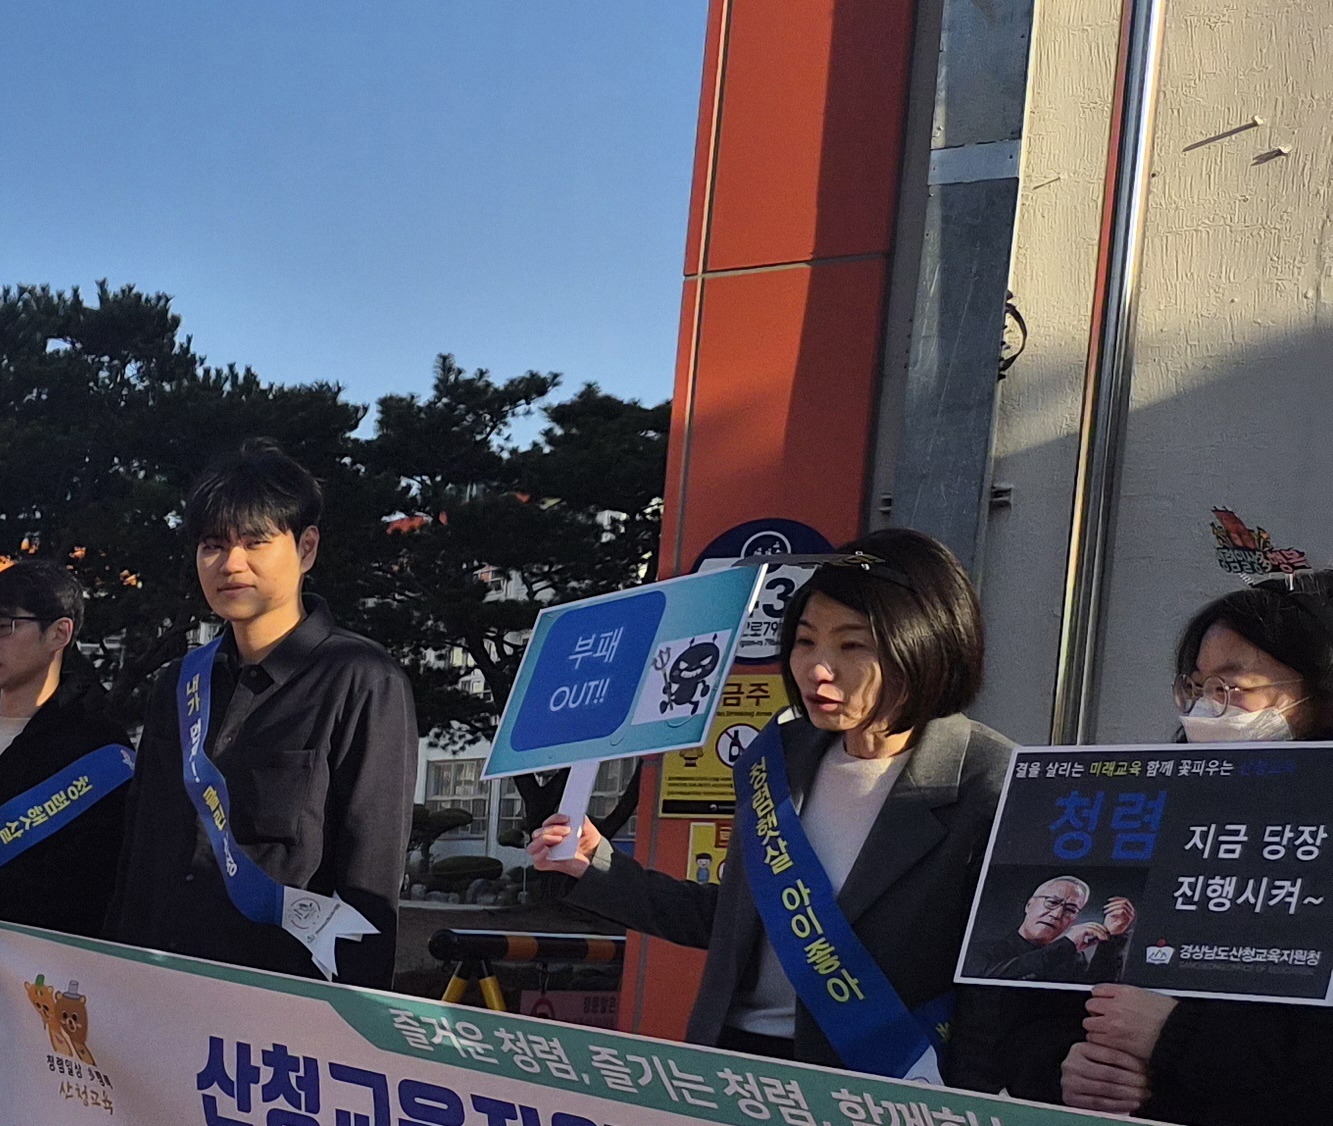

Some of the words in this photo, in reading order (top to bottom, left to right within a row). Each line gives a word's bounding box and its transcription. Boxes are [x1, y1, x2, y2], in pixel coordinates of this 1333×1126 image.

[569, 626, 624, 669] 부패
[186, 672, 201, 717] 내가
[549, 678, 610, 712] OUT!!
[721, 682, 771, 708] 금주
[1015, 761, 1042, 779] 결을
[1045, 760, 1085, 778] 살리는
[1089, 760, 1142, 778] 미래교육
[1145, 760, 1174, 777] 함께
[1177, 759, 1234, 777] 꽃피우는
[749, 756, 795, 876] 청렴햇살
[1048, 790, 1168, 860] 청렴
[1184, 824, 1249, 859] 지금
[1262, 824, 1328, 860] 당장
[1179, 944, 1323, 966] 경상남도산청교육지원청
[390, 1007, 498, 1059] 즐거운
[498, 1022, 590, 1085] 청렴,
[589, 1042, 719, 1107] 즐기는
[59, 1081, 113, 1116] 산청교육
